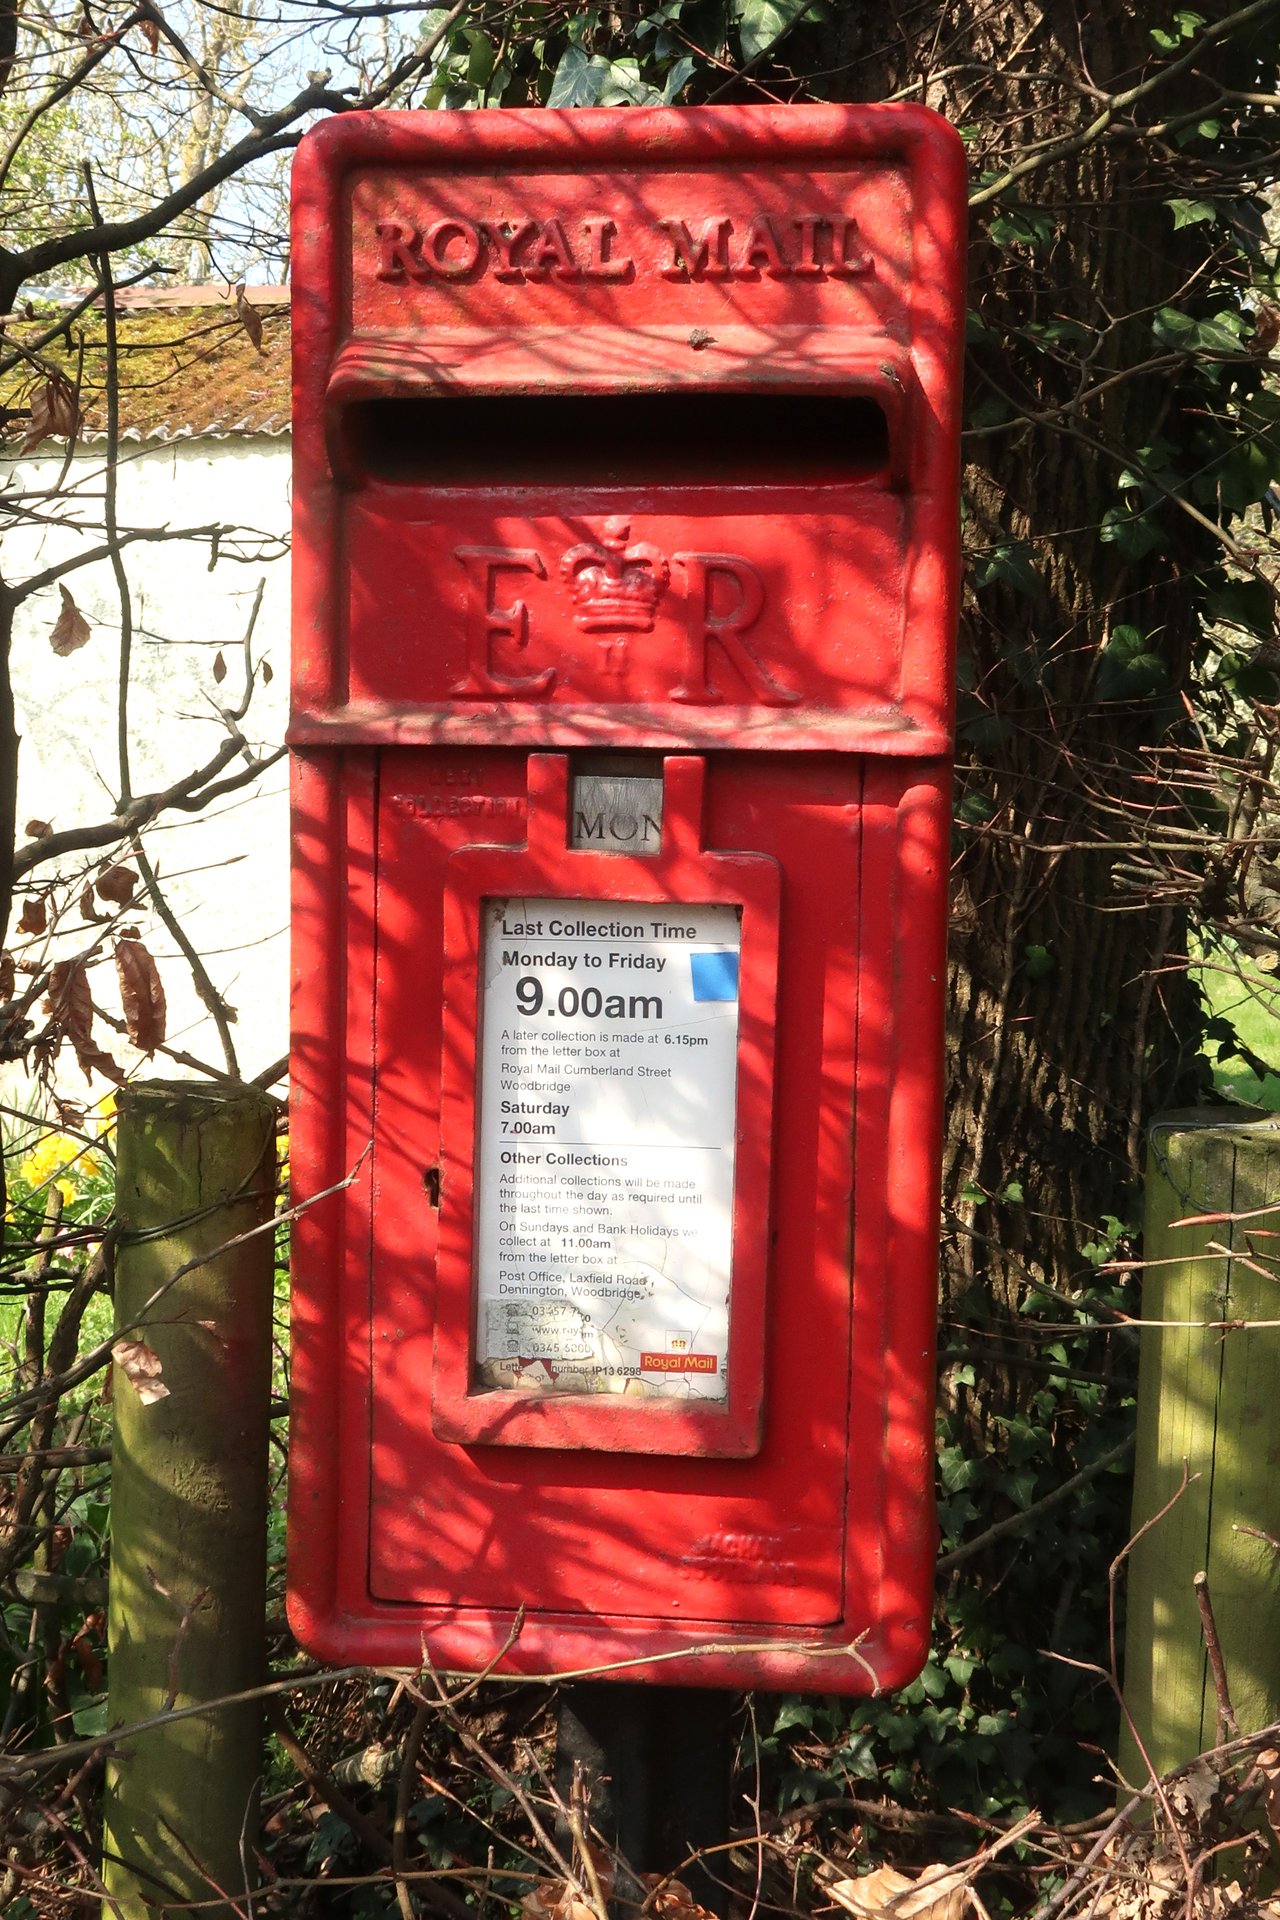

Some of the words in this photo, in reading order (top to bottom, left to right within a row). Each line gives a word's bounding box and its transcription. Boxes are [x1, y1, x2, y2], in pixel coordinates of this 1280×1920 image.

[375, 216, 635, 286] ROYAL
[660, 214, 875, 283] MAIL
[574, 811, 661, 841] MON
[502, 920, 543, 935] Last
[549, 920, 644, 937] Collection
[650, 923, 696, 939] Time
[502, 951, 578, 970] Monday
[584, 954, 602, 968] to
[609, 953, 666, 972] Friday
[516, 976, 663, 1019] 9.00am
[501, 1030, 510, 1040] A
[513, 1030, 538, 1040] later
[541, 1031, 596, 1042] collection
[600, 1032, 609, 1042] is
[612, 1032, 644, 1043] made
[648, 1034, 658, 1044] at
[665, 1034, 708, 1047] 6.15pm
[501, 1045, 528, 1055] from
[531, 1046, 549, 1056] the
[552, 1046, 582, 1056] letter
[585, 1047, 606, 1057] box
[609, 1047, 620, 1057] at
[501, 1063, 533, 1077] Royal
[537, 1064, 560, 1075] Mail
[564, 1065, 634, 1077] Cumberland
[637, 1066, 672, 1077] Street
[501, 1080, 571, 1093] Woodbridge
[501, 1100, 569, 1117] Saturday
[501, 1121, 555, 1135] 7.00am
[500, 1152, 540, 1164] Other
[546, 1152, 628, 1166] Collections
[500, 1174, 556, 1184] Additional
[560, 1176, 621, 1186] collections
[625, 1178, 642, 1187] will
[646, 1178, 660, 1188] be
[664, 1179, 696, 1190] made
[500, 1188, 561, 1200] throughout
[566, 1190, 584, 1200] the
[587, 1191, 608, 1203] day
[612, 1193, 624, 1202] as
[628, 1193, 674, 1204] required
[678, 1194, 702, 1204] until
[500, 1203, 516, 1213] the
[521, 1204, 540, 1214] last
[545, 1205, 568, 1214] time
[572, 1205, 612, 1216] shown.
[500, 1221, 516, 1232] On
[520, 1222, 568, 1235] Sundays
[572, 1224, 594, 1234] and
[598, 1224, 626, 1234] Bank
[630, 1225, 678, 1238] Holidays
[500, 1236, 536, 1246] collect
[540, 1238, 550, 1246] at
[562, 1238, 611, 1248] 11.00am
[500, 1252, 525, 1262] from
[529, 1252, 546, 1262] the
[550, 1253, 579, 1264] letter
[582, 1254, 603, 1264] box
[606, 1256, 618, 1264] at
[500, 1270, 525, 1281] Post
[528, 1270, 566, 1284] Office,
[570, 1272, 612, 1284] Laxfield
[500, 1284, 568, 1298] Dennington,
[500, 1362, 524, 1372] Lette
[592, 1366, 614, 1376] IP13
[616, 1366, 642, 1376] 6298
[644, 1356, 680, 1370] Royal
[684, 1358, 713, 1369] Mail
